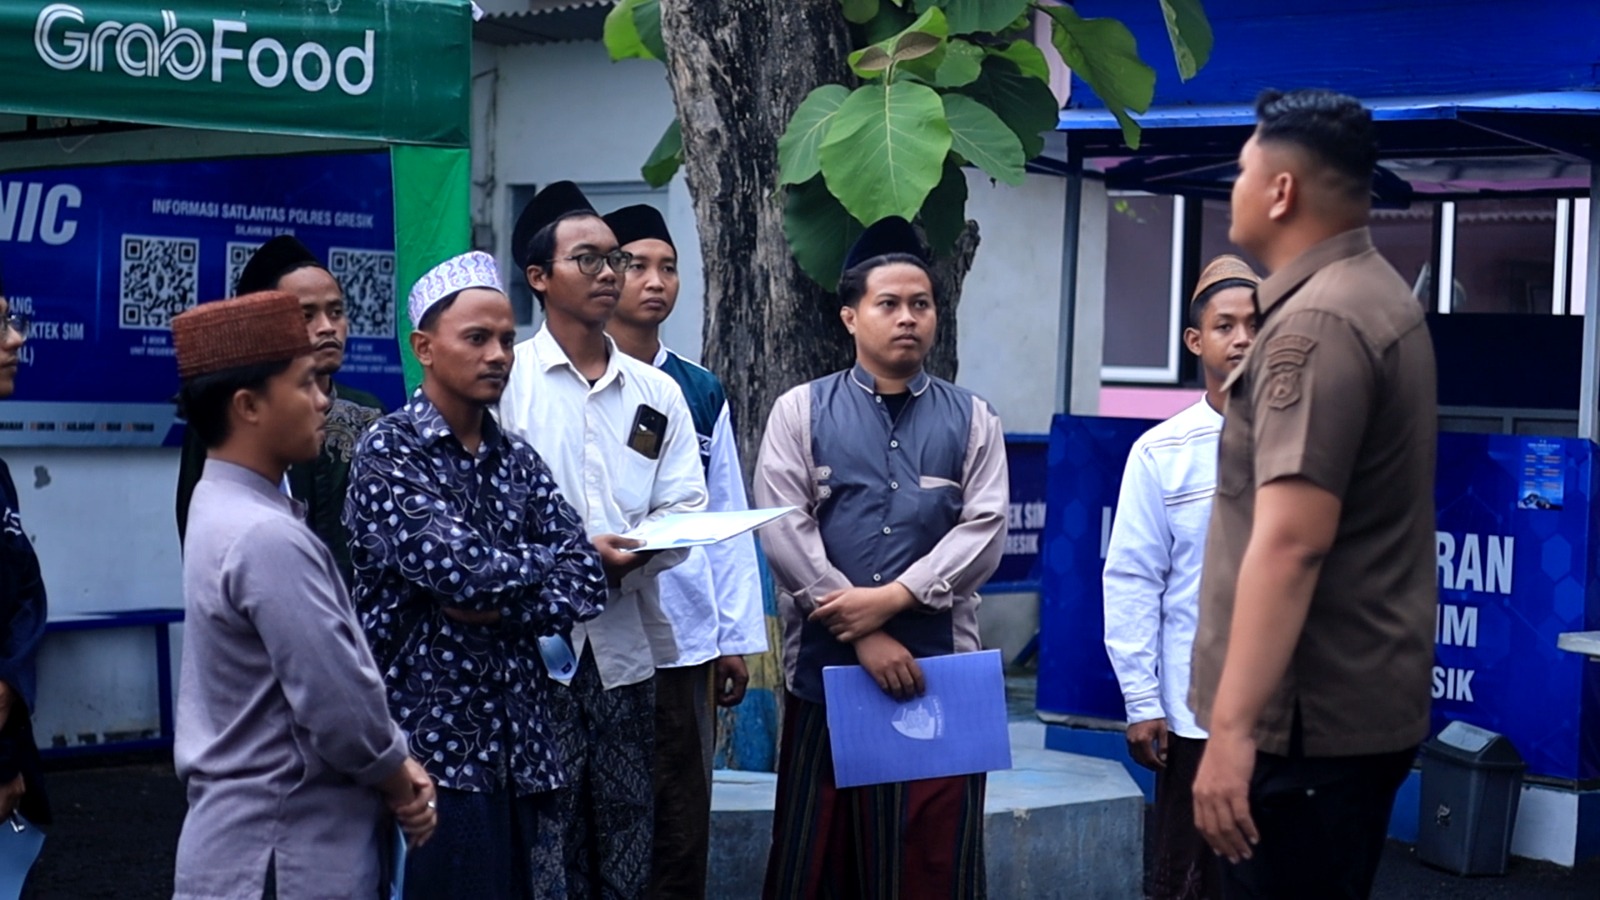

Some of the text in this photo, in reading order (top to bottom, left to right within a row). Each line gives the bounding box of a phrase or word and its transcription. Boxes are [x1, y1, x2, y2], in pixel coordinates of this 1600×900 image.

[34, 3, 375, 96] GrabFood
[0, 180, 82, 246] NIC
[152, 198, 374, 229] INFORMASI SATLANTAS POLRES GRESIK
[62, 322, 84, 340] SIM
[1435, 530, 1515, 595] RAN
[1431, 665, 1475, 702] SIK
